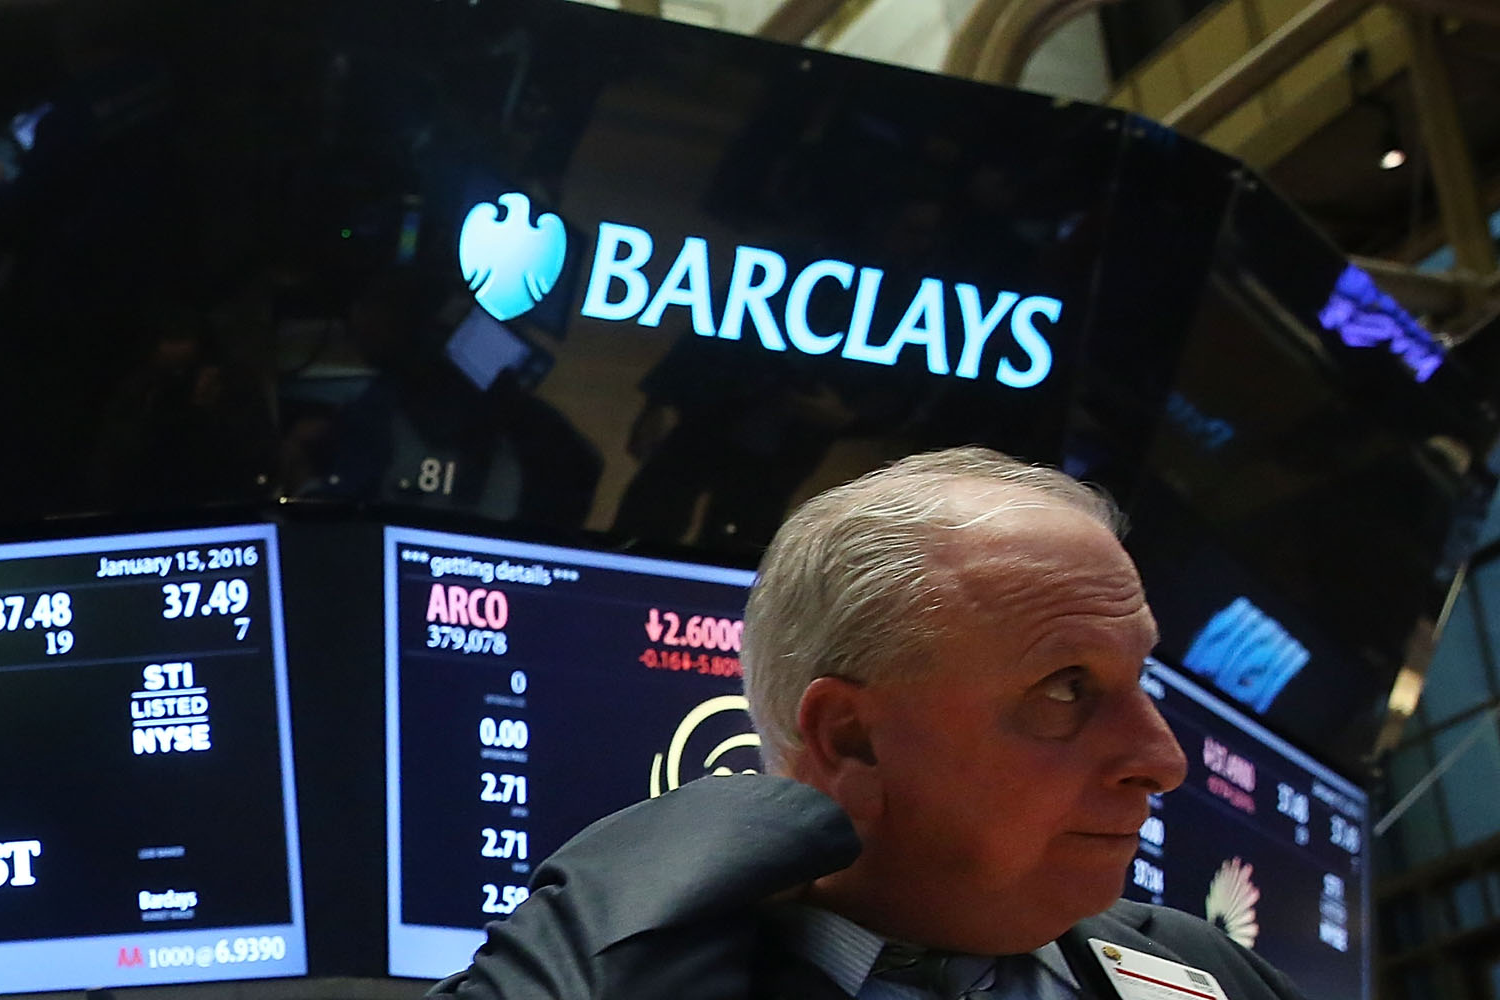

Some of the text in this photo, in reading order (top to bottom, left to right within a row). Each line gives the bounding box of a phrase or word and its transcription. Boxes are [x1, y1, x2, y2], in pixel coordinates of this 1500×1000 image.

[580, 221, 1062, 389] BARCLAYS
[97, 546, 258, 578] January 15, 2016
[430, 556, 551, 586] getting details
[163, 579, 249, 620] 37.49
[426, 584, 508, 630] ARCO
[46, 629, 74, 655] 19
[233, 617, 251, 641] 7
[427, 624, 507, 655] 379,078
[143, 662, 193, 691] STI
[511, 671, 527, 694] 0
[130, 696, 209, 720] LISTED
[132, 724, 212, 755] NYSE
[479, 717, 528, 749] 0.00
[480, 772, 527, 804] 2.71
[481, 828, 527, 859] 2.71
